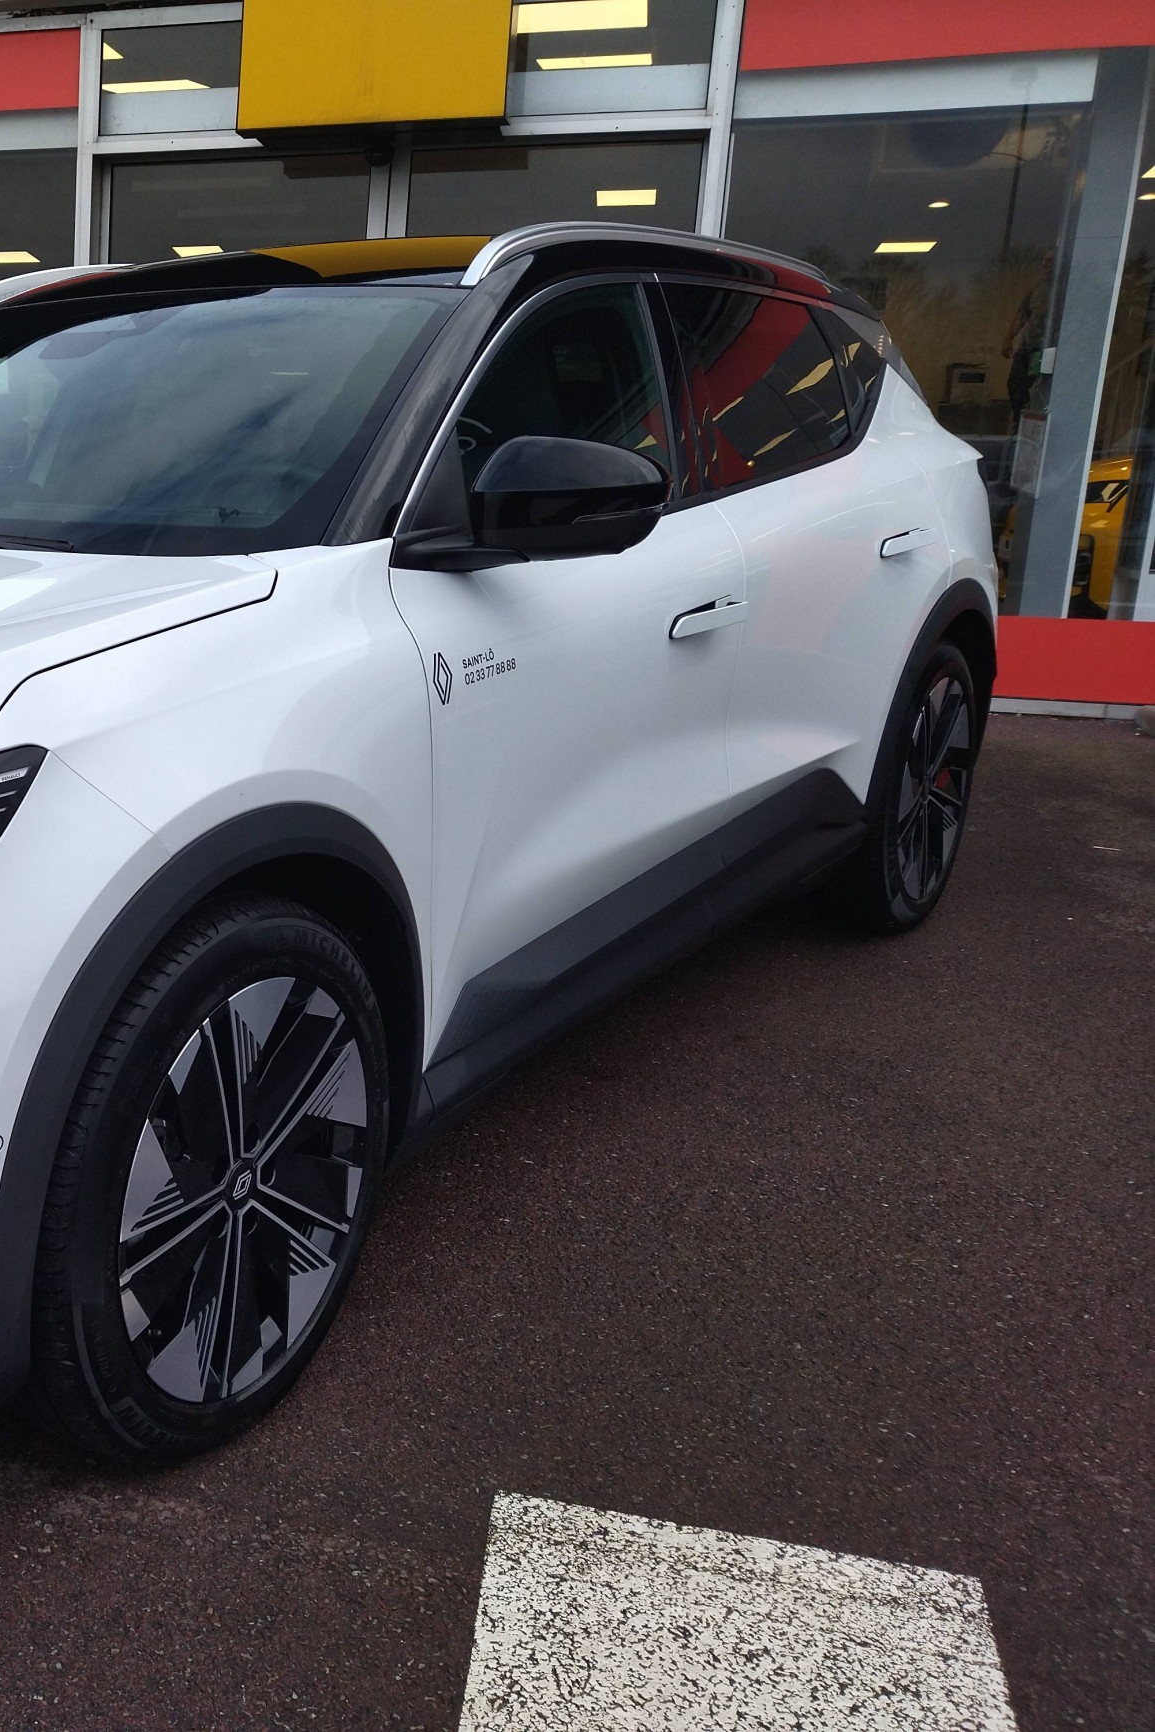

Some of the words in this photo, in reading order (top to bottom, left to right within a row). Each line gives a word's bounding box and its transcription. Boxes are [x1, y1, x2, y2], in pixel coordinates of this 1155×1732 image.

[462, 648, 495, 669] SAINT-LÔ
[464, 671, 475, 685] 02
[475, 668, 486, 681] 33
[486, 664, 495, 678] 77
[294, 927, 372, 997] MICHELIN
